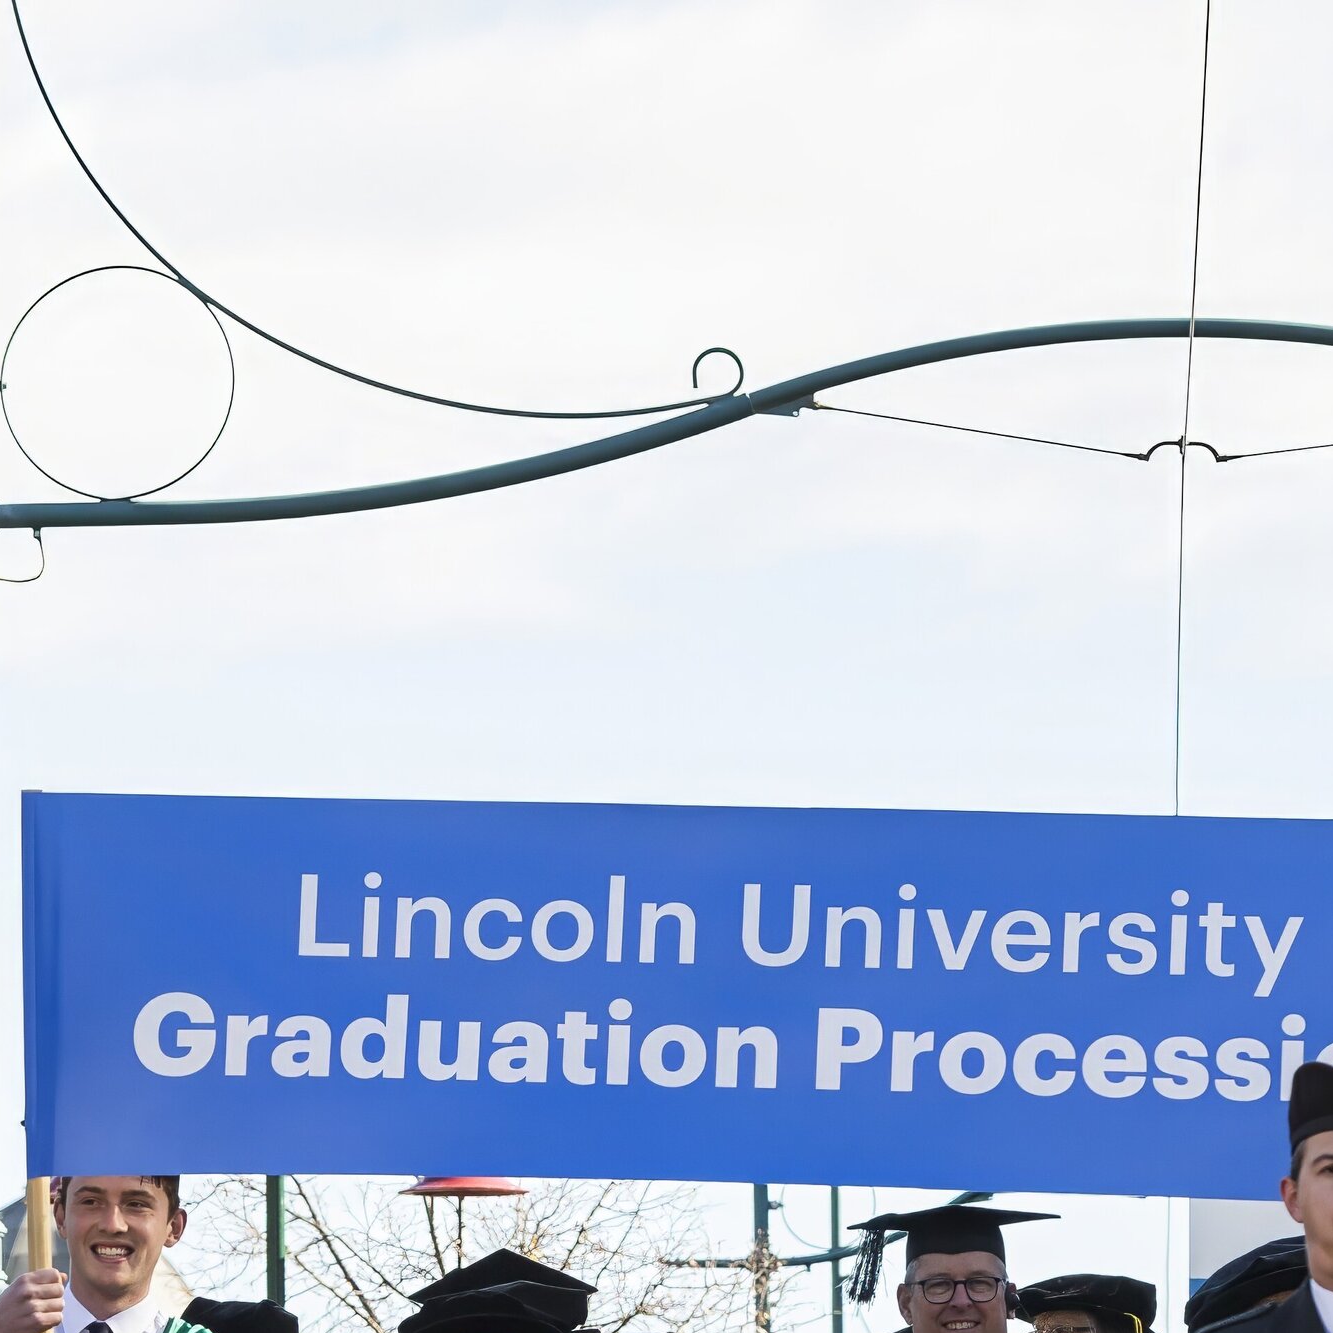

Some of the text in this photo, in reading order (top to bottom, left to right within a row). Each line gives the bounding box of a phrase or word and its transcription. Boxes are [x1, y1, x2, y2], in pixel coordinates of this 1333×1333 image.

[298, 871, 1305, 998] Lincoln University
[133, 991, 778, 1089] Graduation
